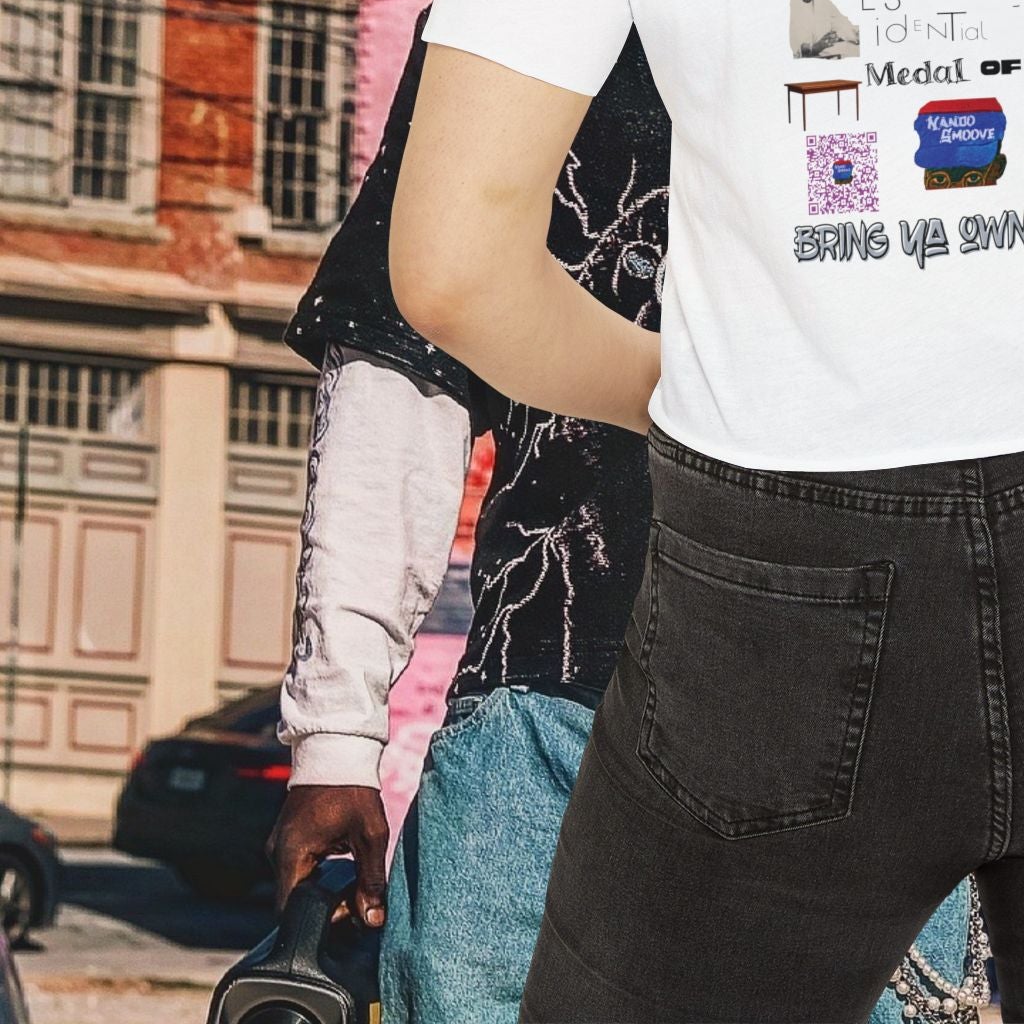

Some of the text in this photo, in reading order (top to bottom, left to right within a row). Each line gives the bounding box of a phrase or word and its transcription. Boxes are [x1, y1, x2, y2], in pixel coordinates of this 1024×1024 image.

[866, 58, 971, 87] Medal
[980, 59, 1021, 76] OF
[926, 115, 976, 131] NANDO
[940, 128, 995, 143] SMOOVE
[793, 221, 890, 263] BRING
[898, 217, 950, 270] YA
